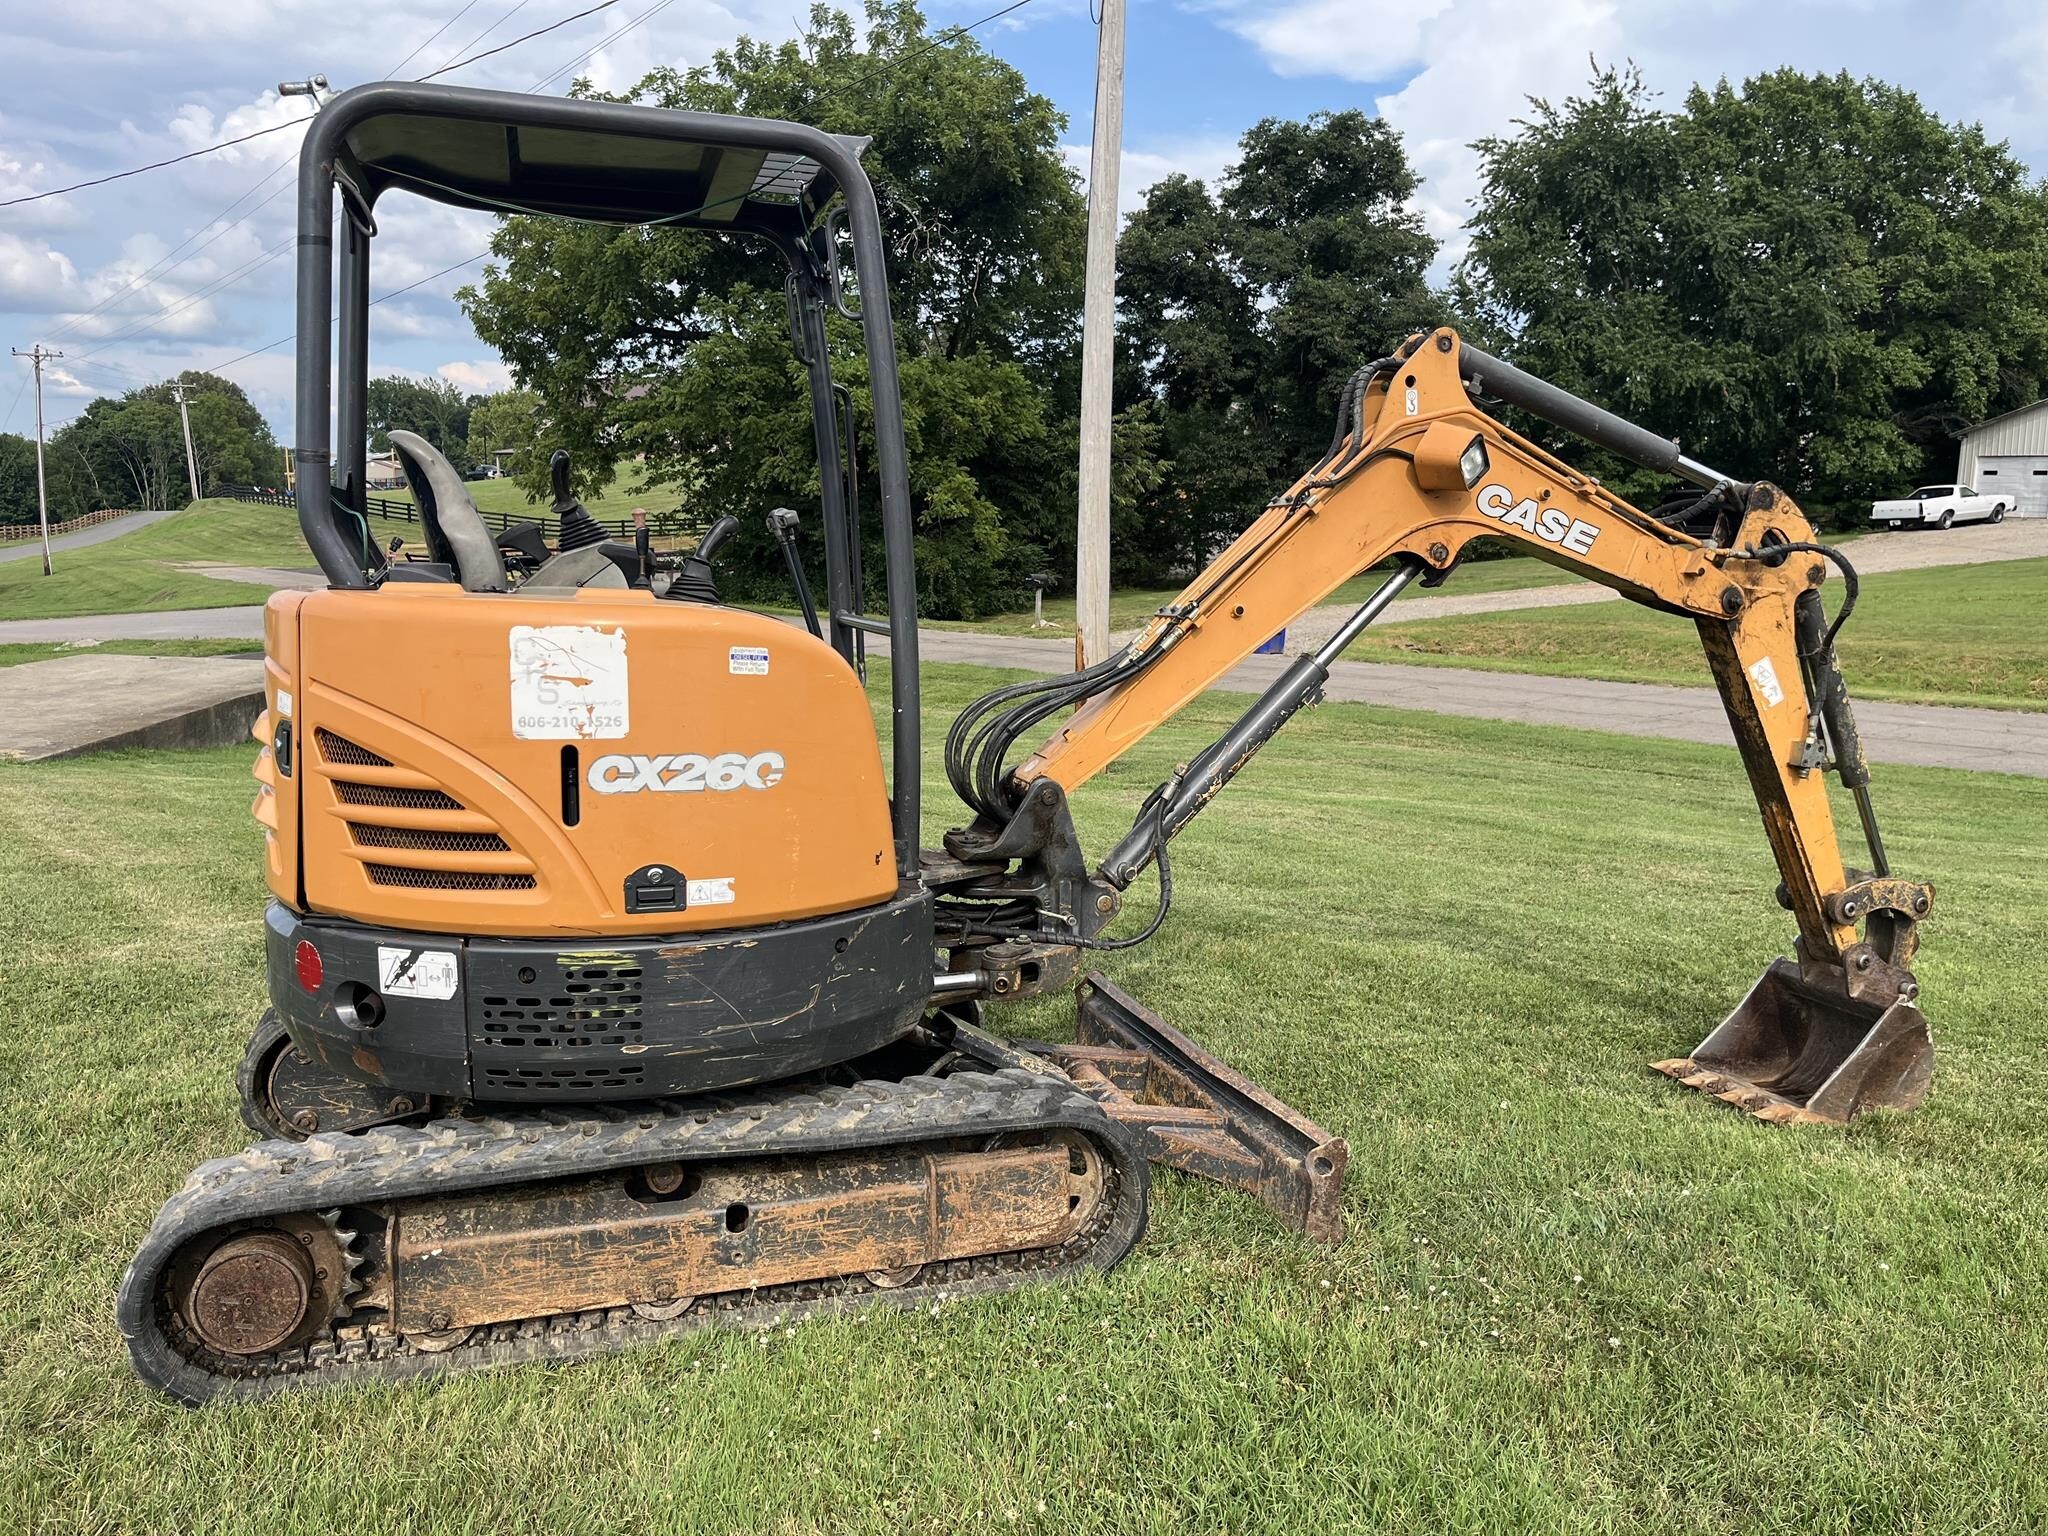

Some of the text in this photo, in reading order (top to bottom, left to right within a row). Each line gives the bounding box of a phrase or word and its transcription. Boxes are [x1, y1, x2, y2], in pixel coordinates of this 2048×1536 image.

[1476, 483, 1601, 556] CASE
[518, 716, 623, 728] 606-210-1526
[587, 753, 785, 794] CX26C
